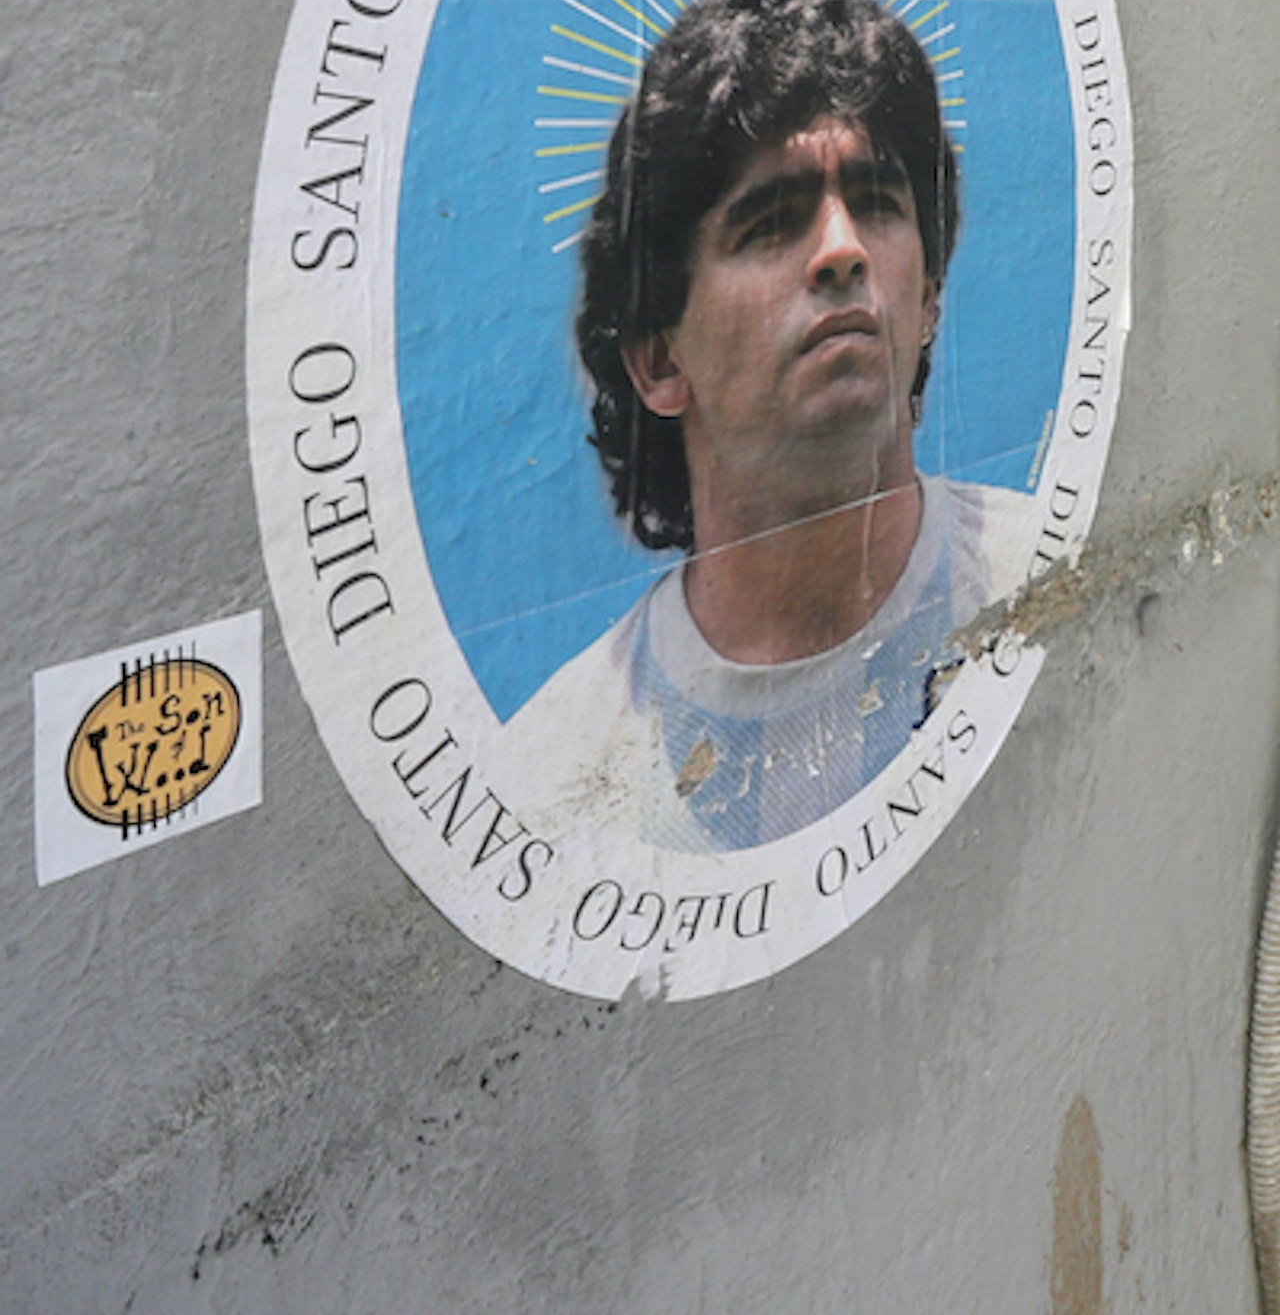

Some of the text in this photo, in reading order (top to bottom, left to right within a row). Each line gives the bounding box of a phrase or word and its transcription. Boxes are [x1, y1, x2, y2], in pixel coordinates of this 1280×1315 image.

[1074, 14, 1117, 197] DIEGO
[1068, 238, 1114, 440] SANTO
[288, 342, 396, 645] DIEGO
[369, 677, 554, 902] SANTO
[815, 709, 978, 896] SANTO
[573, 880, 777, 953] DIEGO
